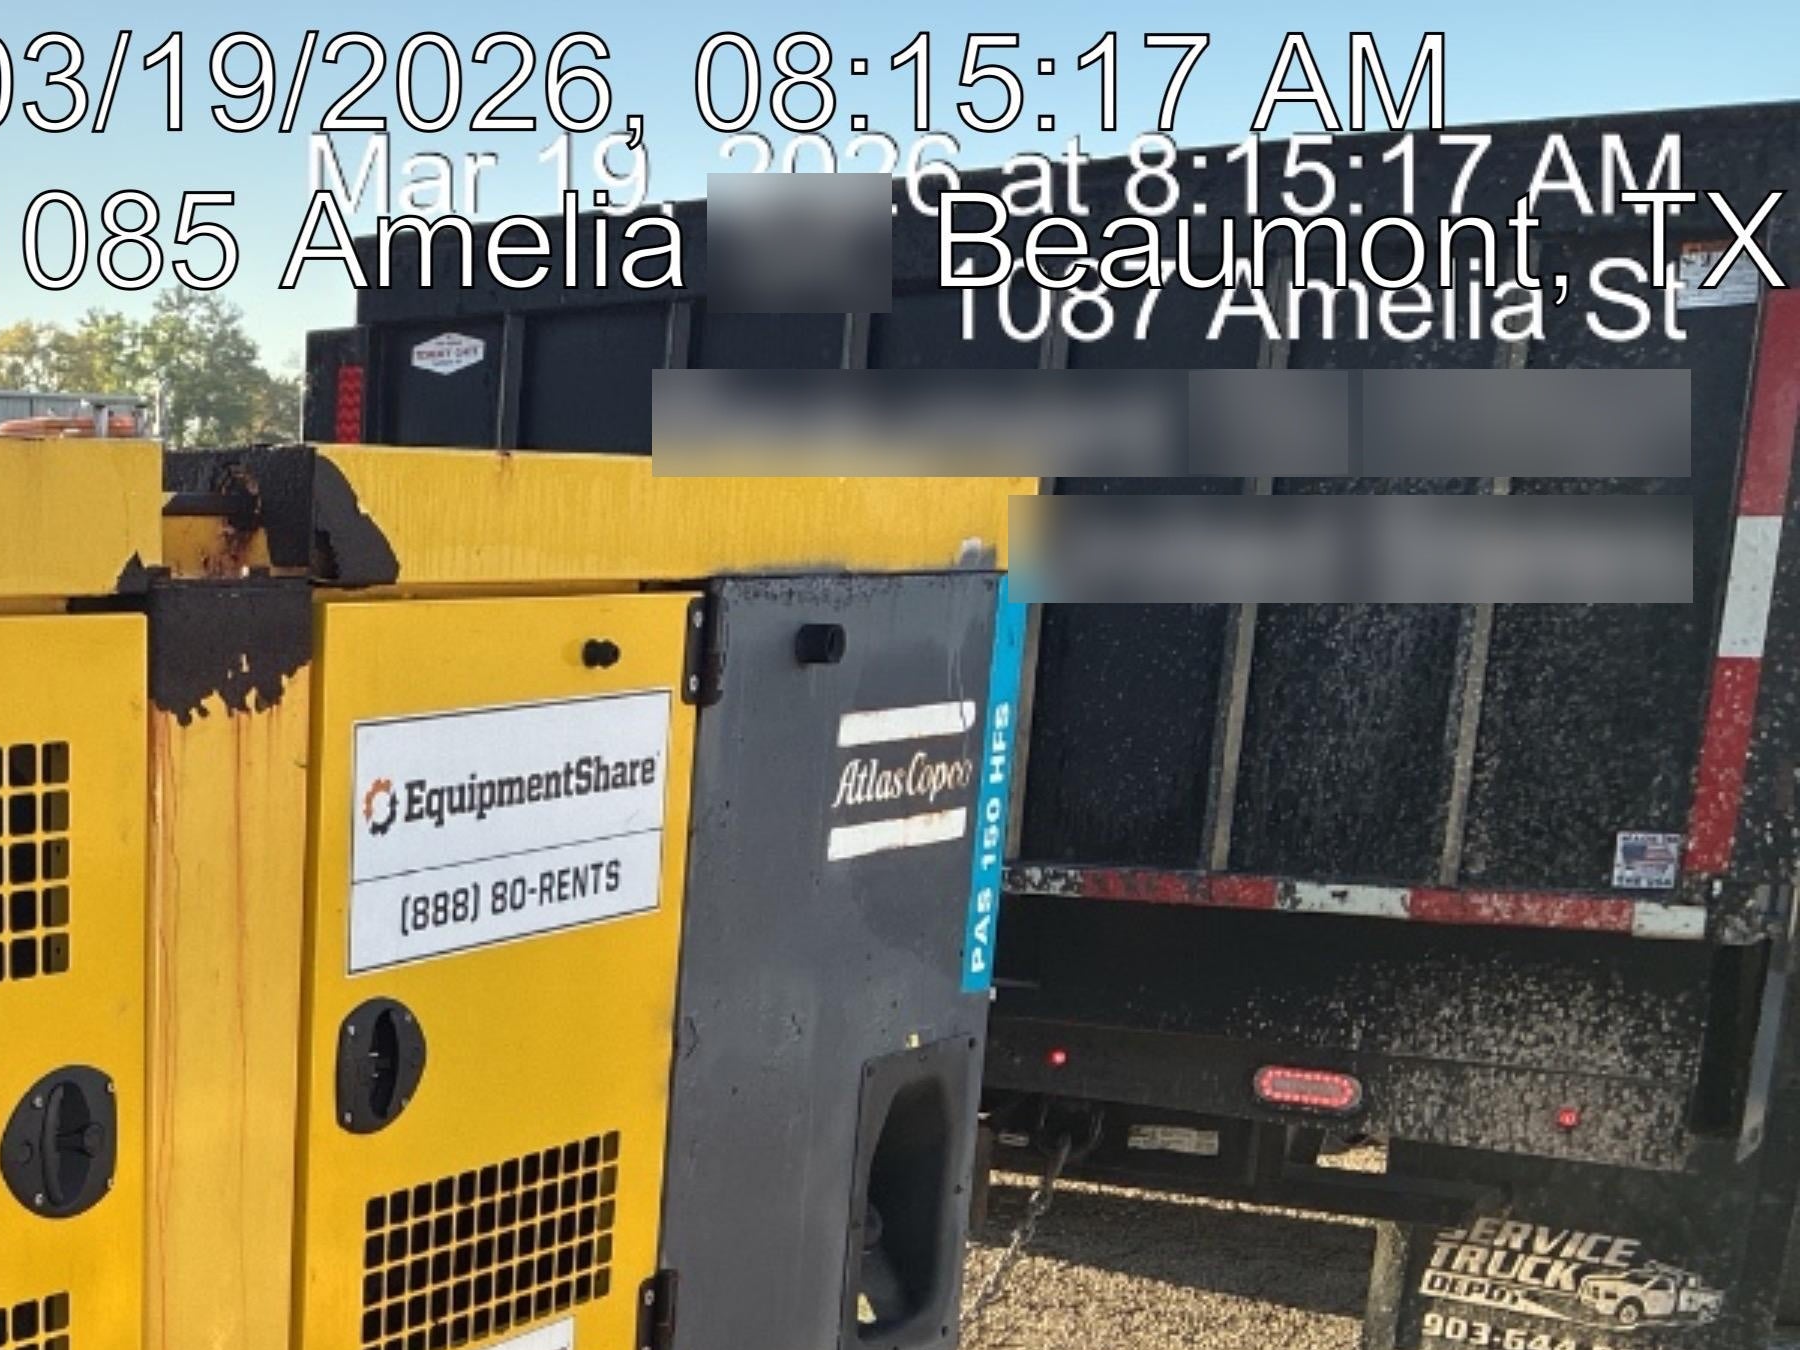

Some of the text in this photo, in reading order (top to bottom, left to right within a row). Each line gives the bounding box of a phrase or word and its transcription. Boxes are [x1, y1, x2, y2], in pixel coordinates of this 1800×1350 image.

[405, 755, 656, 828] EquipmentShare
[830, 757, 906, 808] Atlas
[971, 702, 1010, 973] PAS 150 HFS
[400, 859, 622, 936] (888) 80-RENTS
[1431, 1241, 1583, 1291] TRUCK
